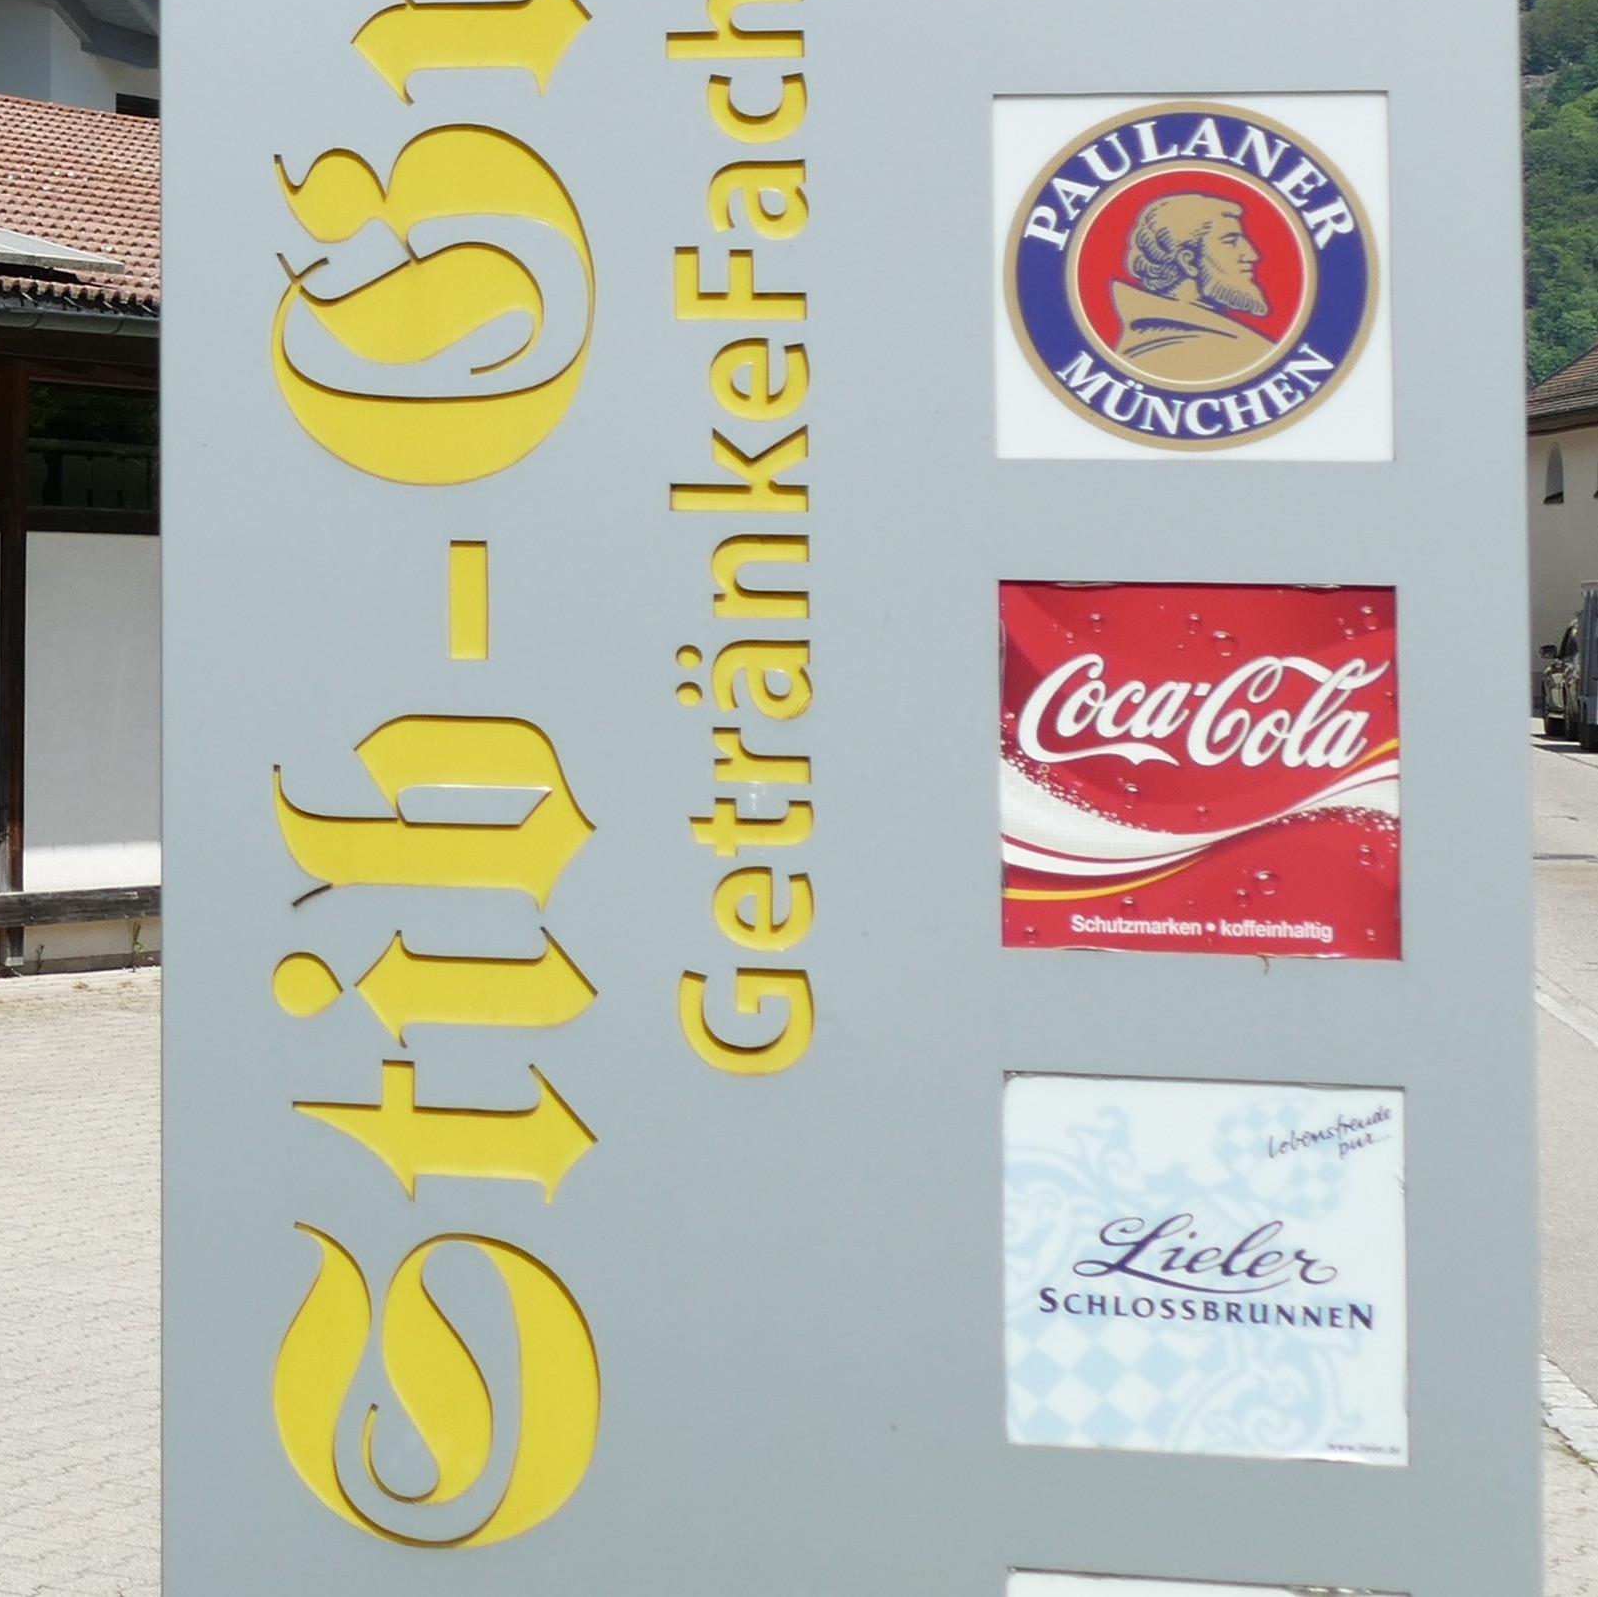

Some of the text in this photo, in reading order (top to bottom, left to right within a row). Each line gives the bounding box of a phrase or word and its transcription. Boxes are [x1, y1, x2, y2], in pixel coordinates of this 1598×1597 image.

[1022, 115, 1357, 253] PAULANER
[1054, 340, 1338, 439] MÜNCHEN
[1017, 651, 1390, 771] Coca-Cola
[1070, 913, 1334, 944] Schutzmarken koffeinhaltig
[1071, 1213, 1337, 1293] Lieler
[1038, 1285, 1374, 1332] SCHLOSSBRUNNEN
